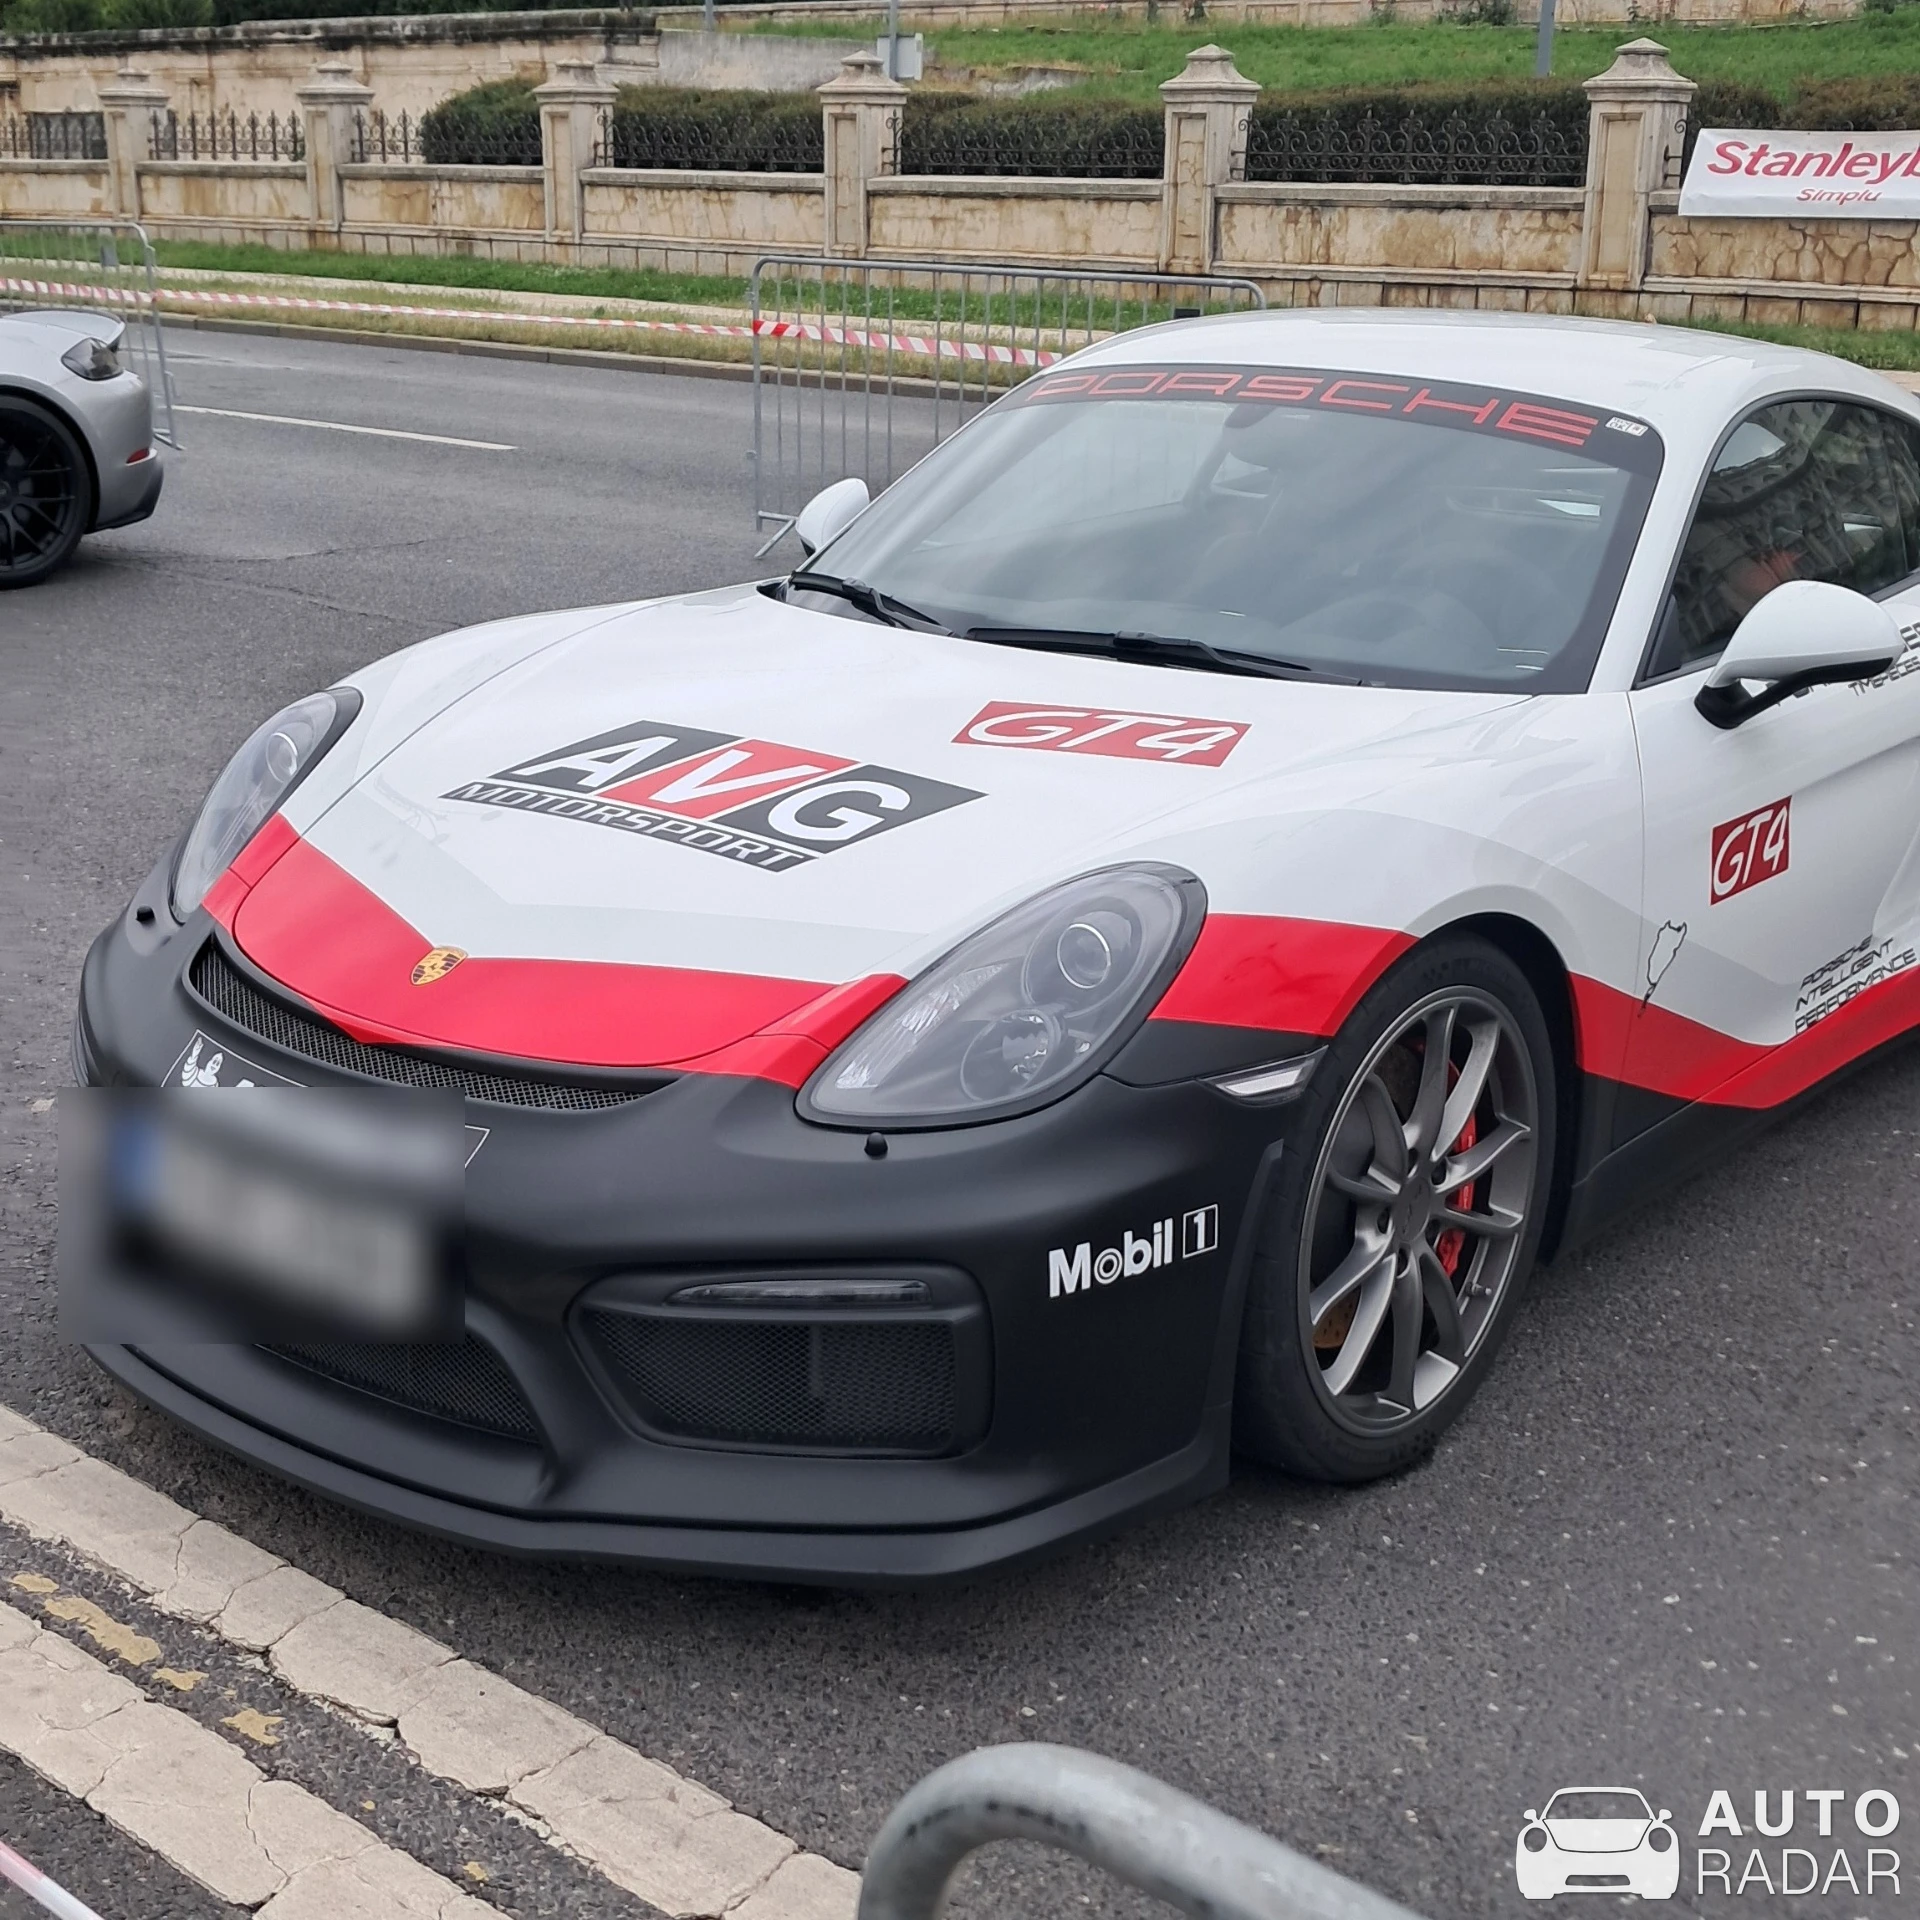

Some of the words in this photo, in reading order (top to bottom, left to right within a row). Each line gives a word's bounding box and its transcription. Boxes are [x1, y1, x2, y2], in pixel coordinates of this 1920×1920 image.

[1796, 188, 1883, 206] Simplu
[1026, 371, 1599, 447] PORSCHE
[967, 710, 1240, 759] GT4
[451, 781, 807, 871] MOTORSPORT
[510, 734, 912, 842] AVG
[1712, 804, 1789, 897] GT4
[1794, 948, 1918, 1034] PERFORMANCE
[1795, 937, 1893, 1012] INTELLIGENT
[1799, 933, 1874, 990] PORSCHE
[1048, 1217, 1174, 1298] Mobil
